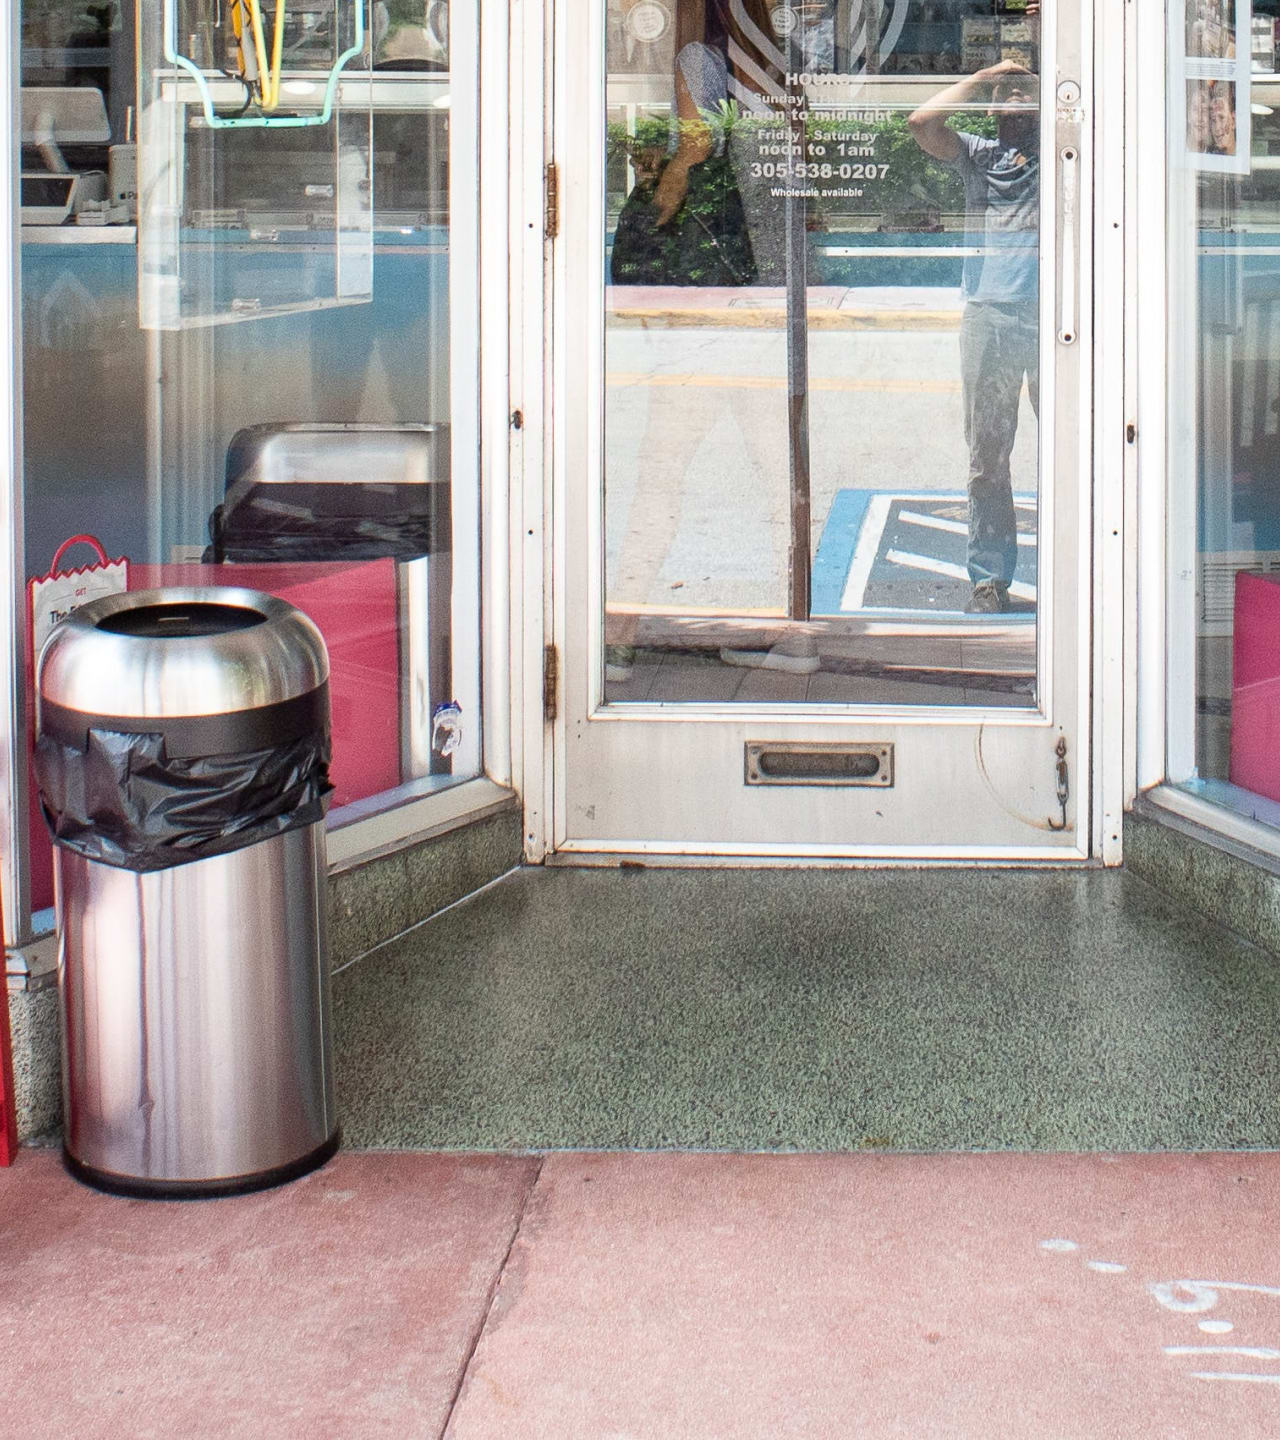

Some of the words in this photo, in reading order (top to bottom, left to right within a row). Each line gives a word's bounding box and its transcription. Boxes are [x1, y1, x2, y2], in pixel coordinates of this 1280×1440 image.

[785, 72, 851, 86] HOURS
[752, 93, 804, 107] Sunday
[791, 109, 809, 121] to
[815, 108, 892, 126] midnight
[757, 129, 800, 143] Friday
[814, 129, 878, 144] Saturday
[759, 145, 802, 156] noon
[807, 143, 826, 156] to
[837, 143, 874, 156] 1am
[750, 163, 890, 179] 305-538-0207
[770, 187, 819, 198] Wholesale
[821, 187, 863, 197] available
